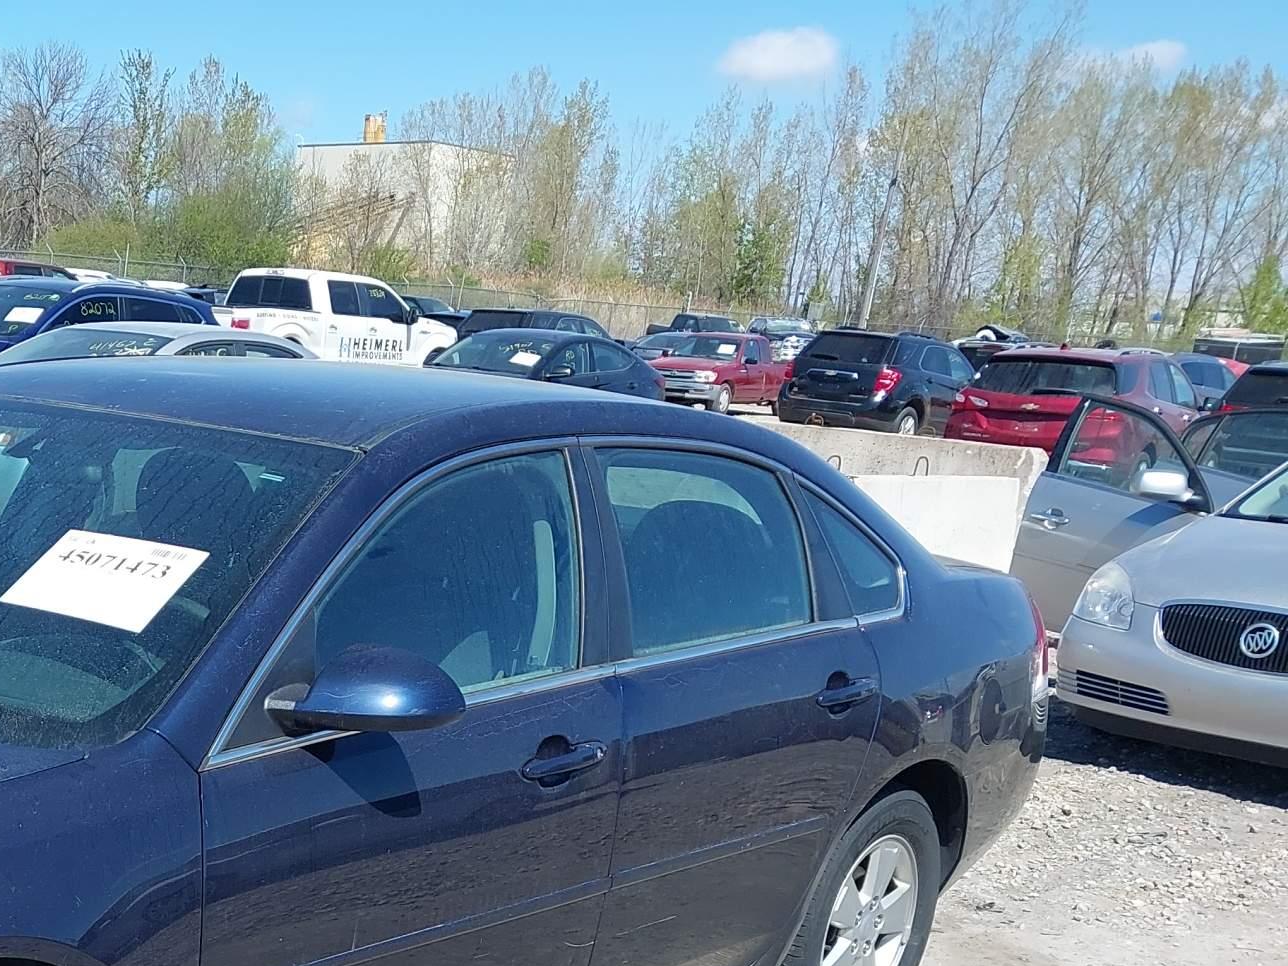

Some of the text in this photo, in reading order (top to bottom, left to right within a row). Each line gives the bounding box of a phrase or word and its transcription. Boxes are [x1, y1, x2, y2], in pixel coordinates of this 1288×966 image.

[80, 302, 116, 316] 82072
[353, 338, 403, 352] HEIMERL
[352, 350, 403, 361] IMPROVEMENTS
[59, 549, 171, 578] 45071473
